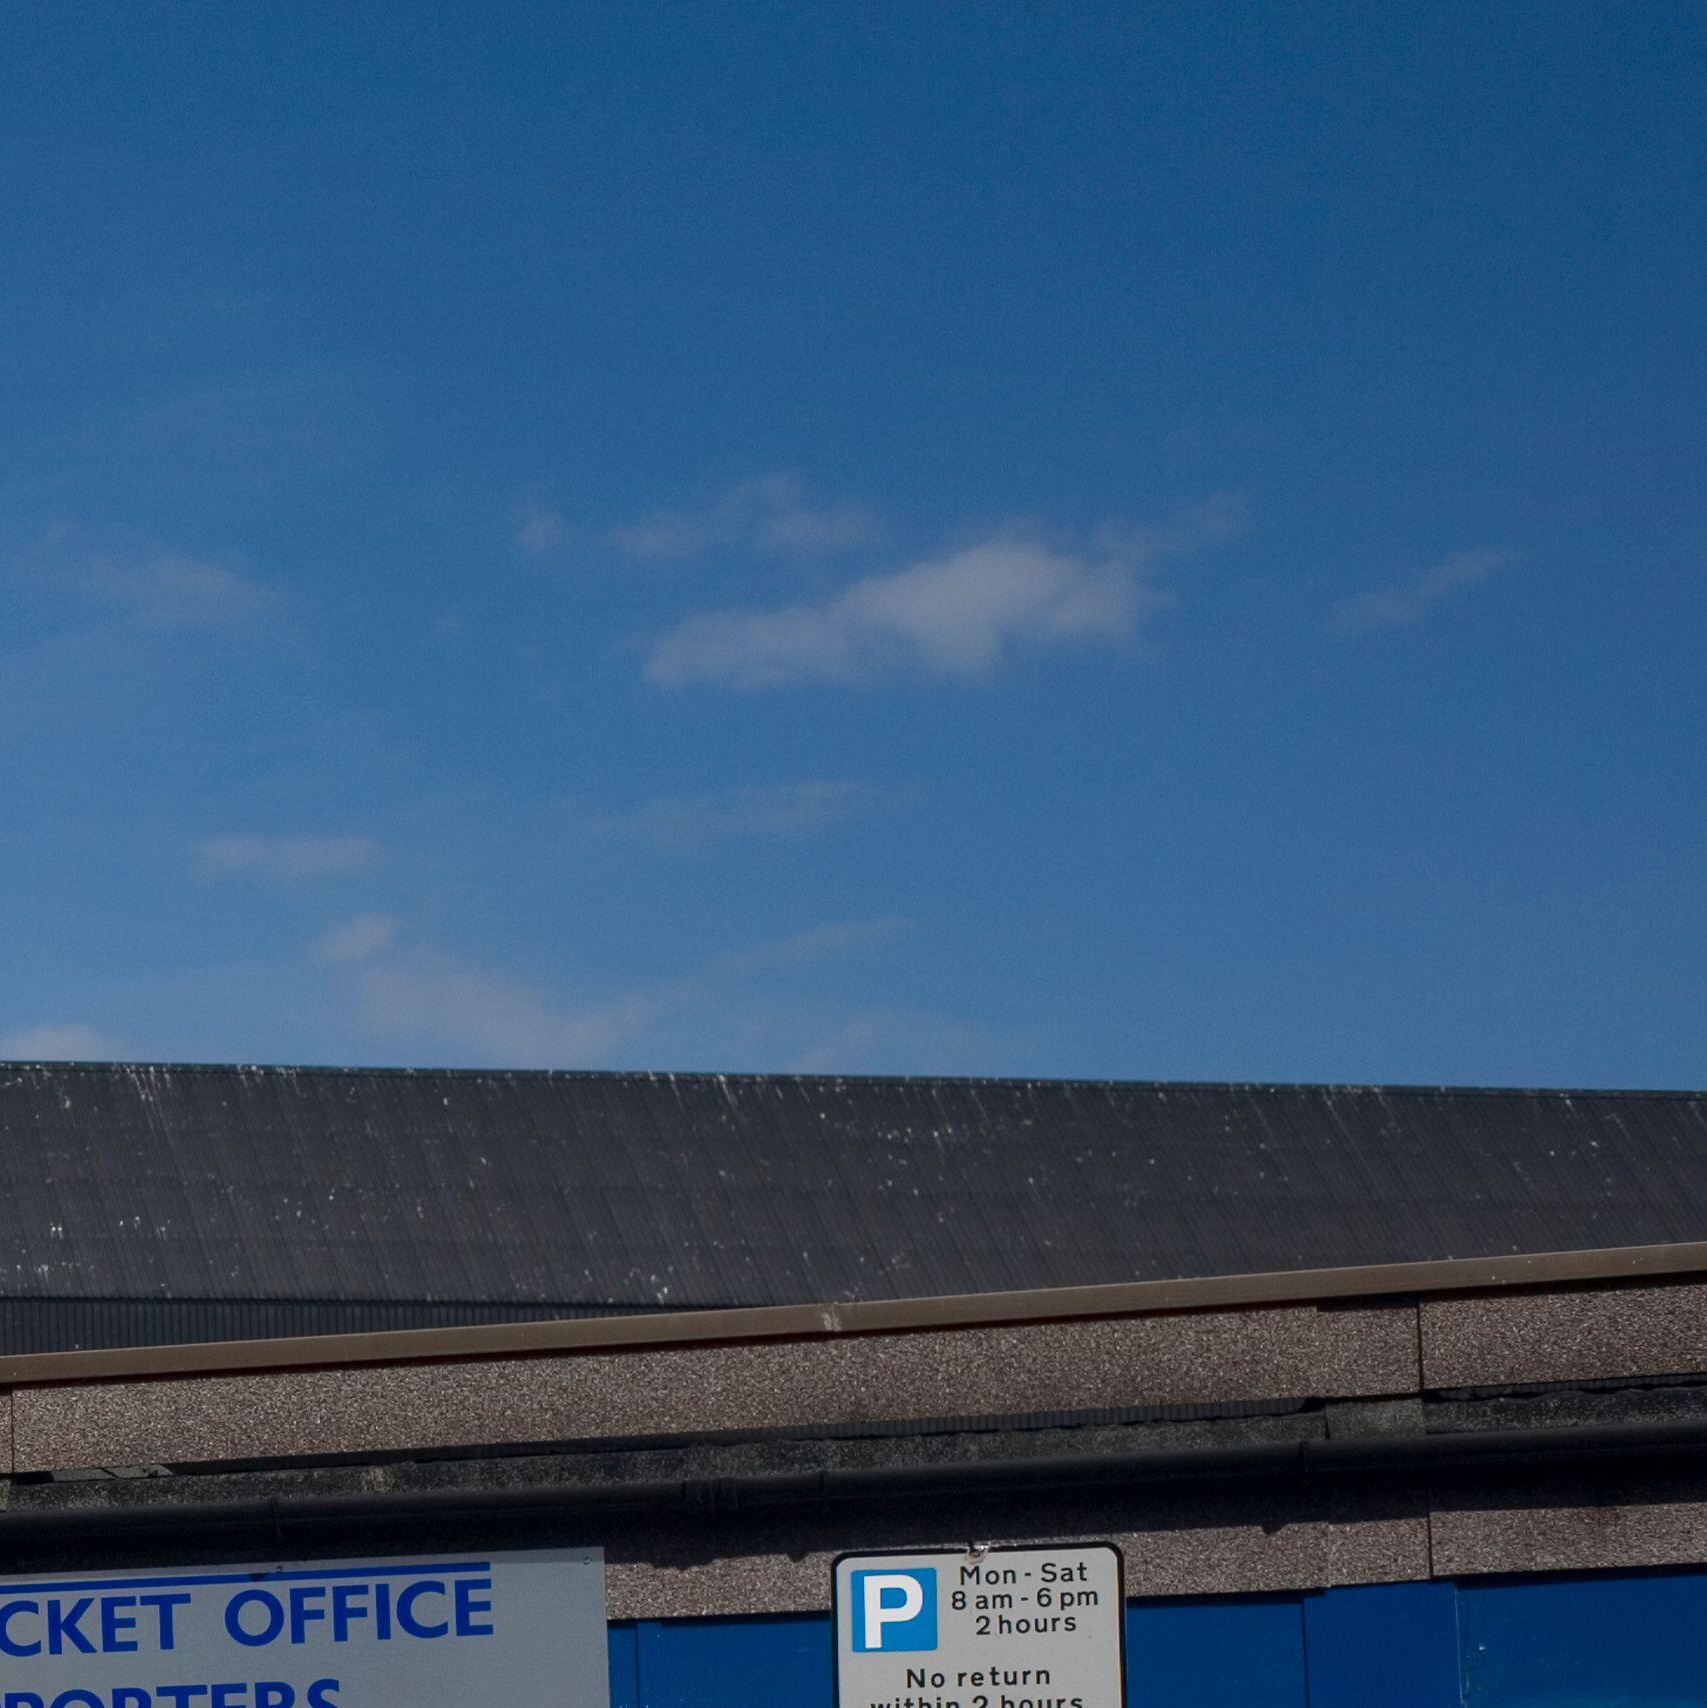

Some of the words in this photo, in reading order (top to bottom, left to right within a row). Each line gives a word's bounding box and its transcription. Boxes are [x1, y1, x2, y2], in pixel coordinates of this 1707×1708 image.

[960, 1565, 1017, 1586] Mon
[1040, 1561, 1088, 1584] Sat
[224, 1576, 495, 1648] OFFICE
[863, 1574, 923, 1649] P
[951, 1590, 967, 1611] 8
[975, 1593, 1013, 1610] am
[1036, 1587, 1053, 1608] 6
[1060, 1590, 1099, 1612] pm
[975, 1614, 991, 1636] 2
[998, 1613, 1077, 1635] hours
[906, 1668, 946, 1689] No
[957, 1666, 1051, 1688] return
